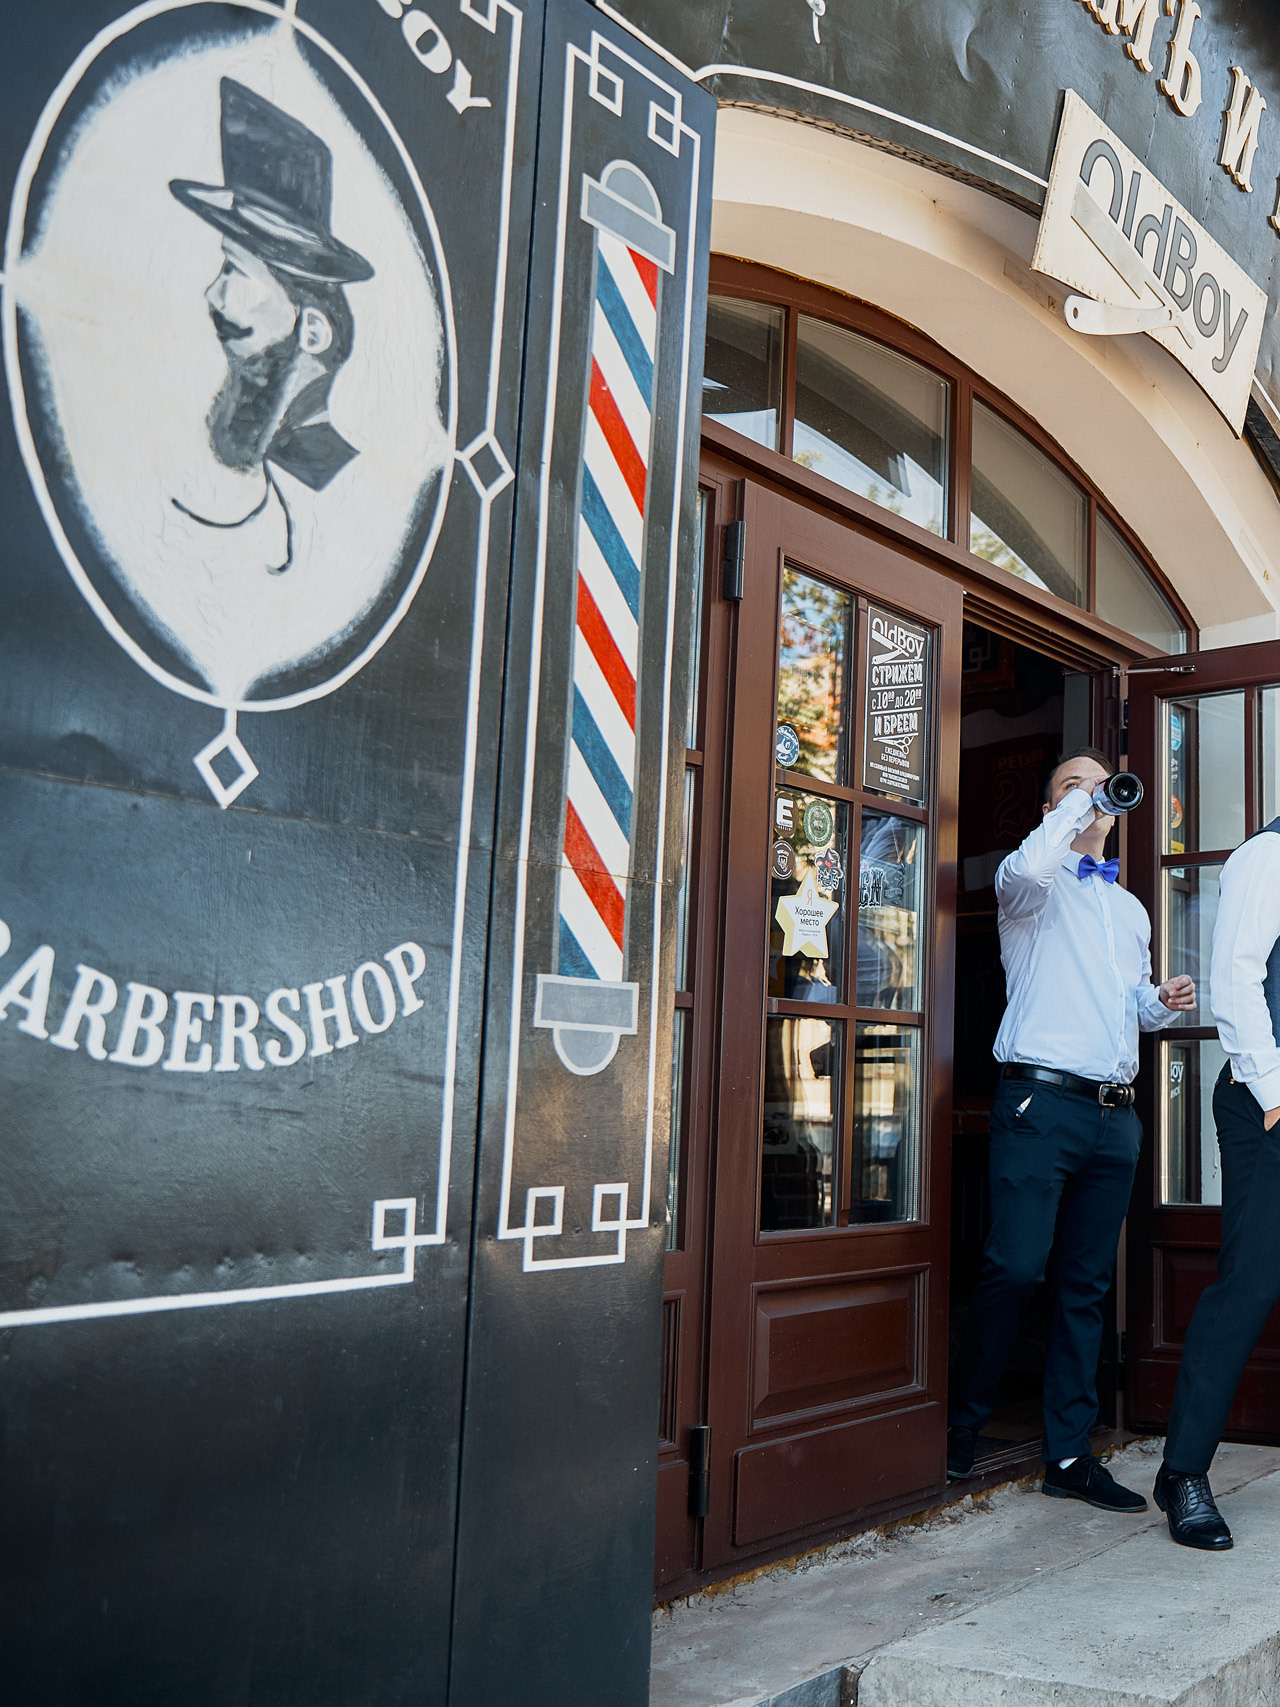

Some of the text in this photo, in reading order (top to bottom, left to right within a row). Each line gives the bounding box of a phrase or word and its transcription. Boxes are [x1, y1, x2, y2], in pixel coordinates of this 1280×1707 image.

[1216, 66, 1267, 193] И
[1079, 138, 1249, 374] OldBoy
[871, 617, 925, 660] OldBoy
[871, 661, 923, 685] СТРИЖЁМ
[874, 712, 919, 736] И БРЕЕМ
[794, 906, 824, 918] Хорошее
[800, 918, 820, 927] место
[0, 919, 427, 1073] ARBERSHOP
